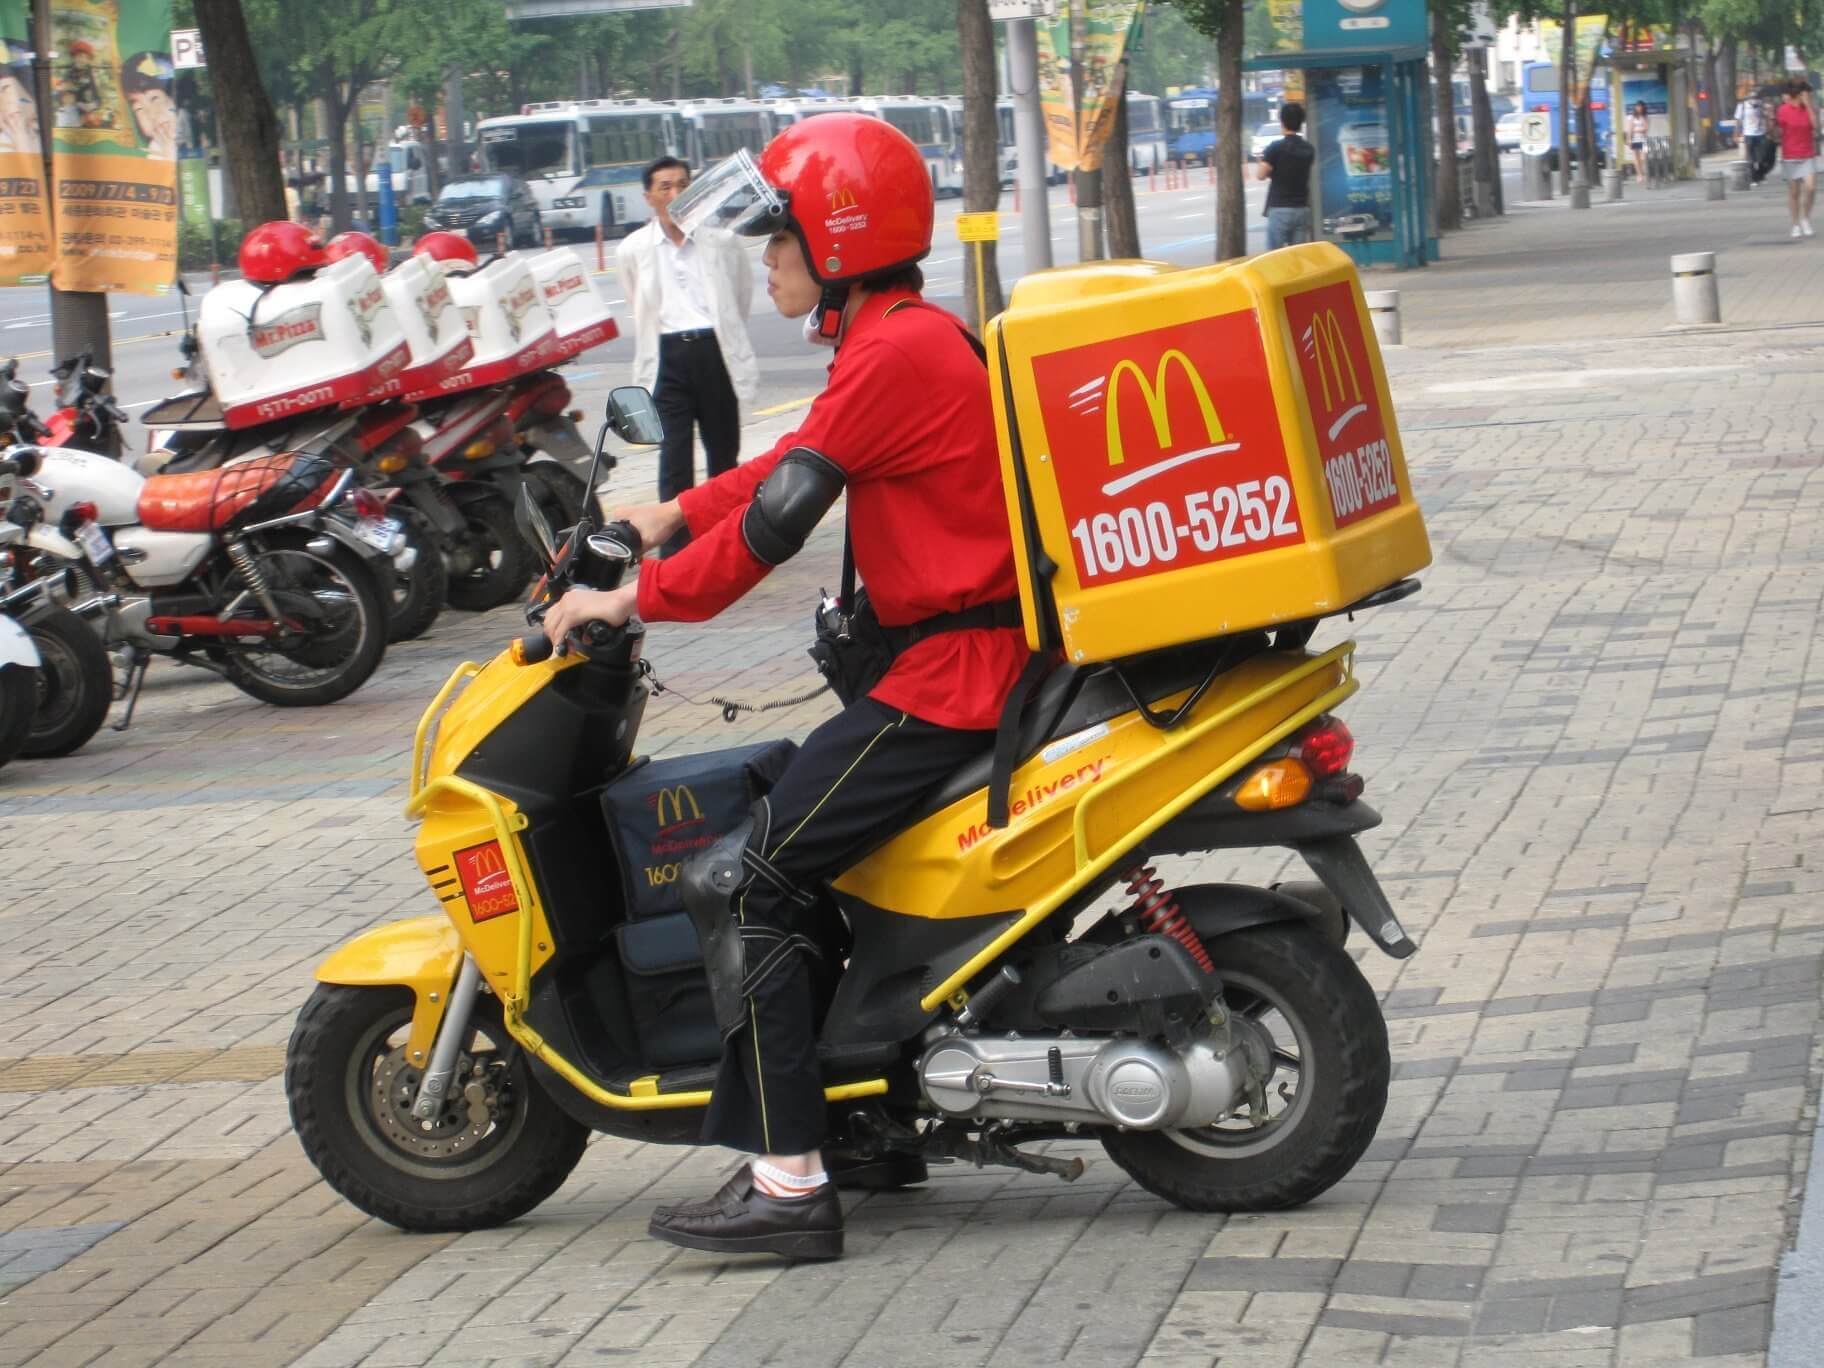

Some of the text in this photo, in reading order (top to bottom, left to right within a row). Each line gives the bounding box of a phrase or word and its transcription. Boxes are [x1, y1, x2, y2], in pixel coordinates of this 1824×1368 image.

[176, 38, 191, 62] P
[825, 214, 867, 227] McDelivery
[1325, 439, 1397, 519] 1600-5252
[1072, 475, 1298, 577] 1600-5252
[474, 879, 512, 896] McDeliver
